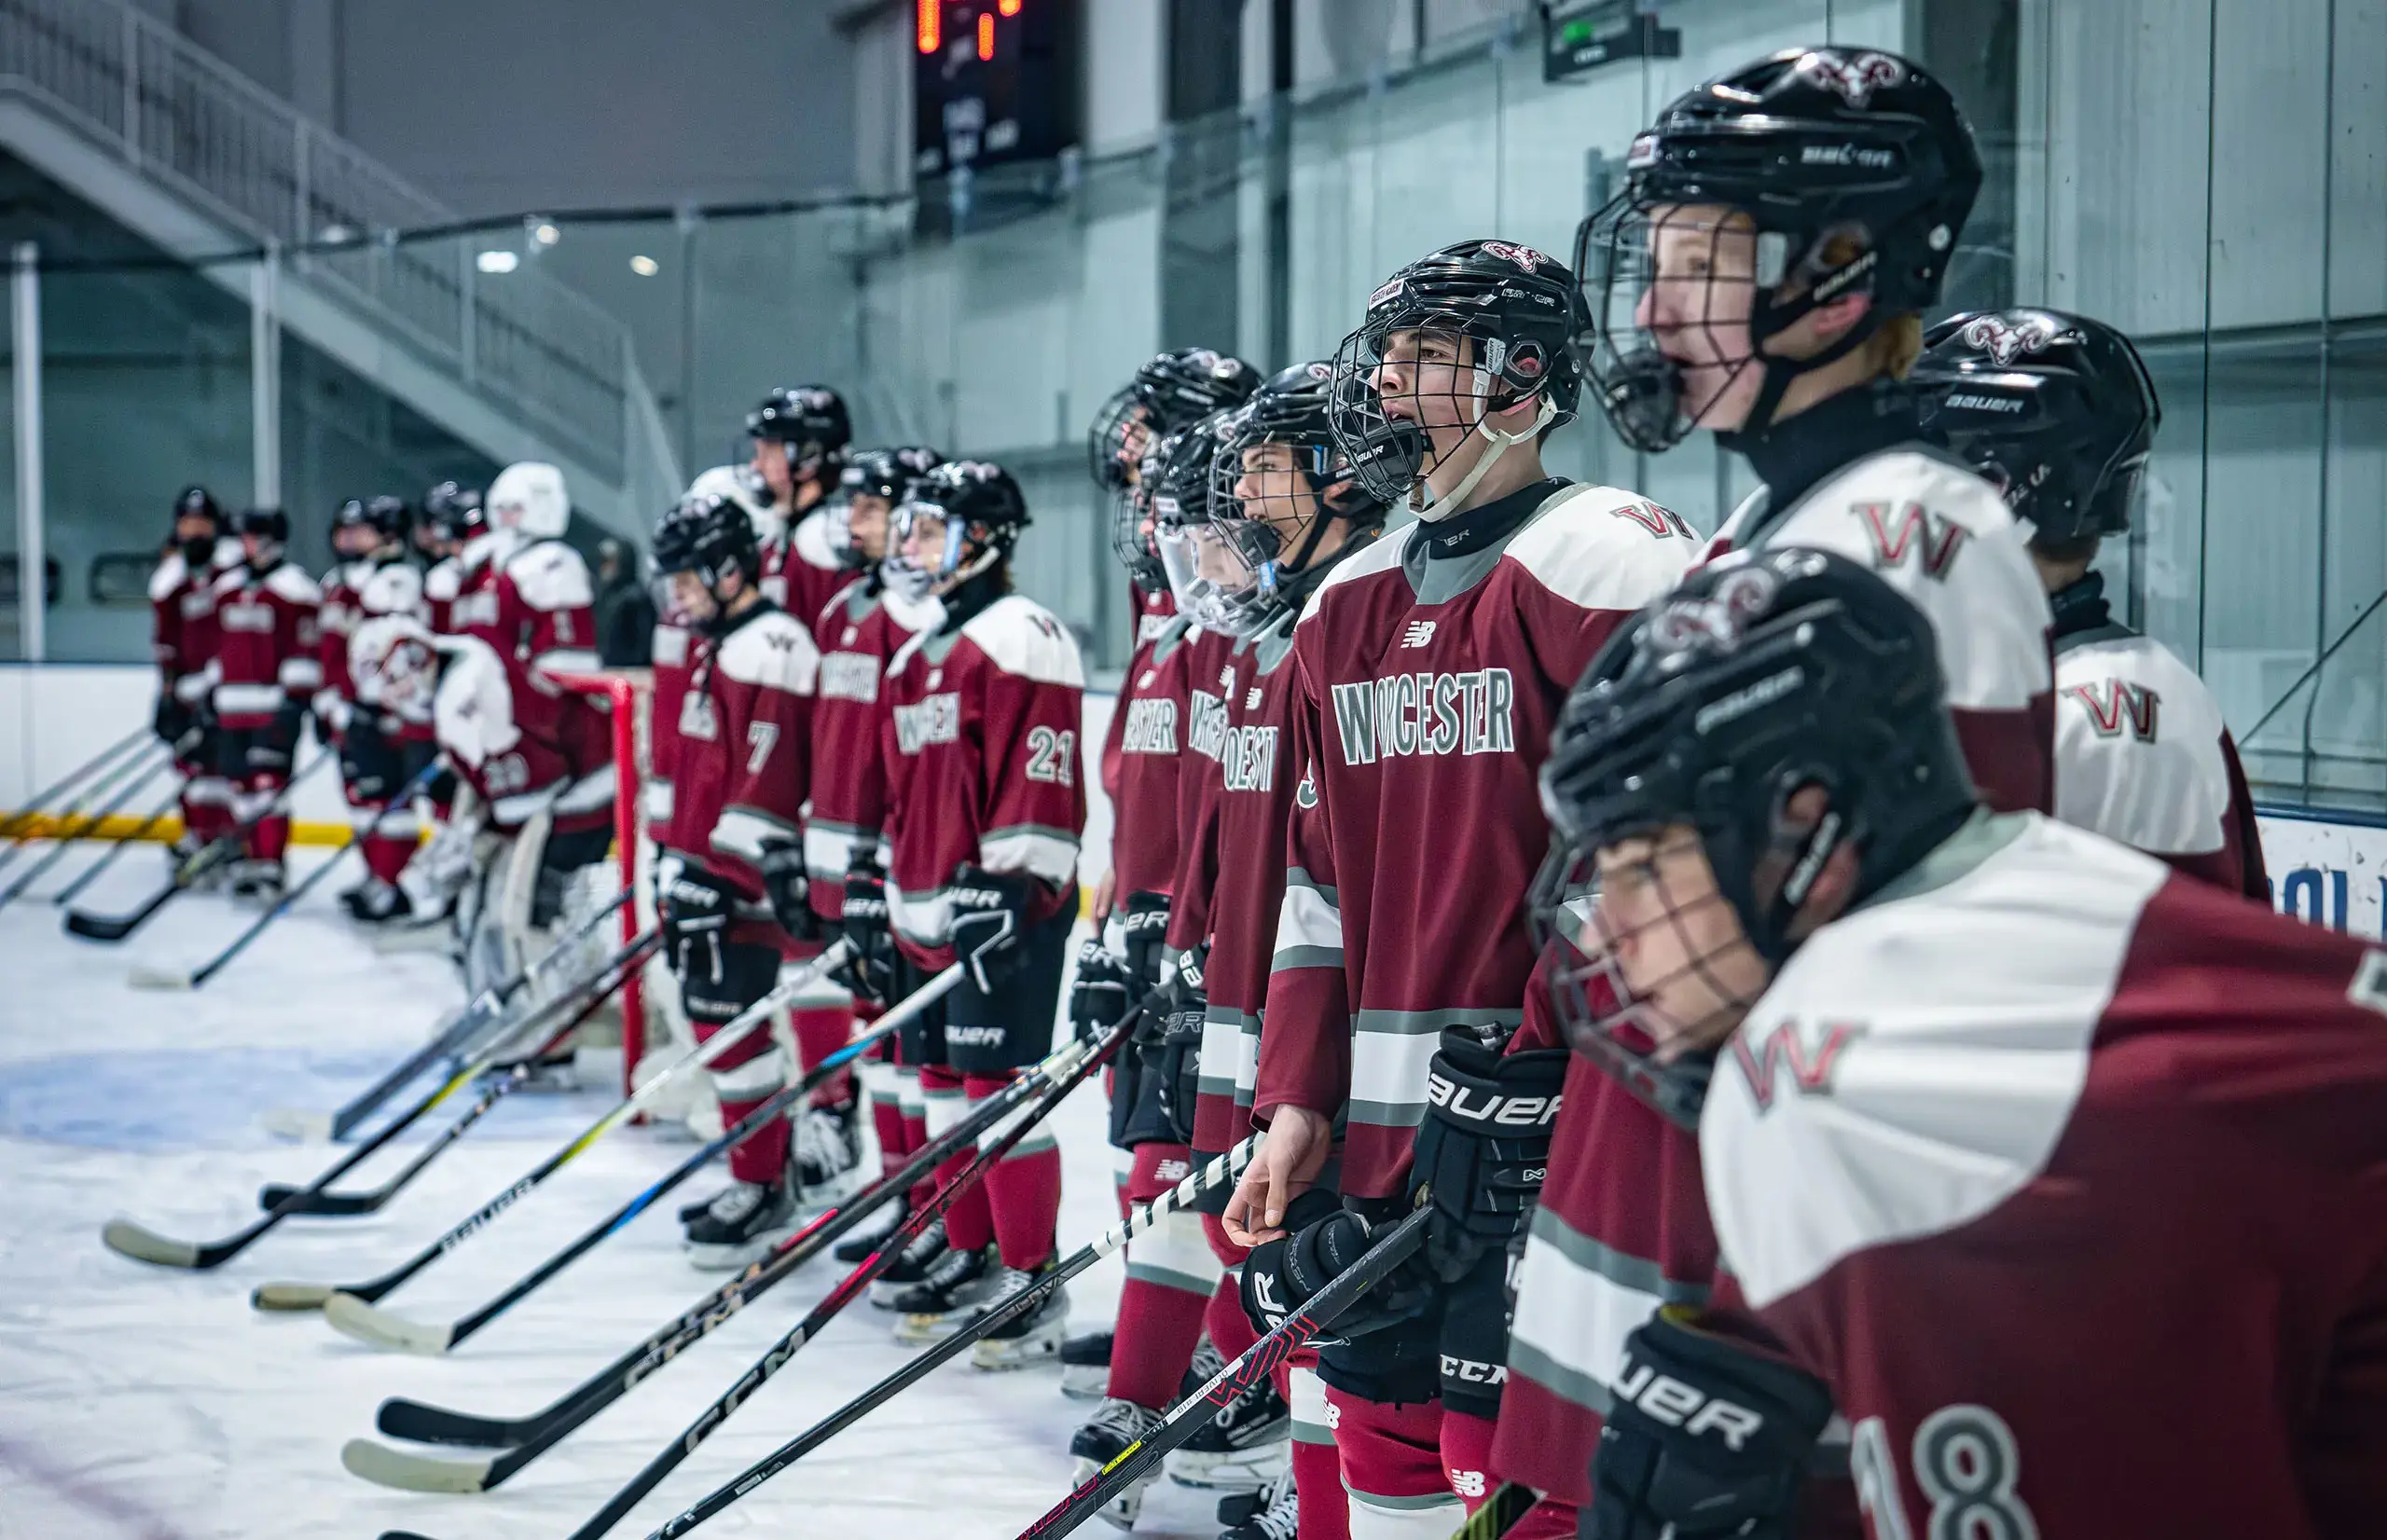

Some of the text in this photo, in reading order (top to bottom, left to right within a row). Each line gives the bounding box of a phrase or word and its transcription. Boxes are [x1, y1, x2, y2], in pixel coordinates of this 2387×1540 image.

[1610, 501, 1694, 541] W
[1850, 500, 1977, 584] W
[2059, 677, 2161, 745] W
[746, 721, 780, 775] 7
[1026, 725, 1075, 789] 21
[1850, 1402, 2041, 1540] 18
